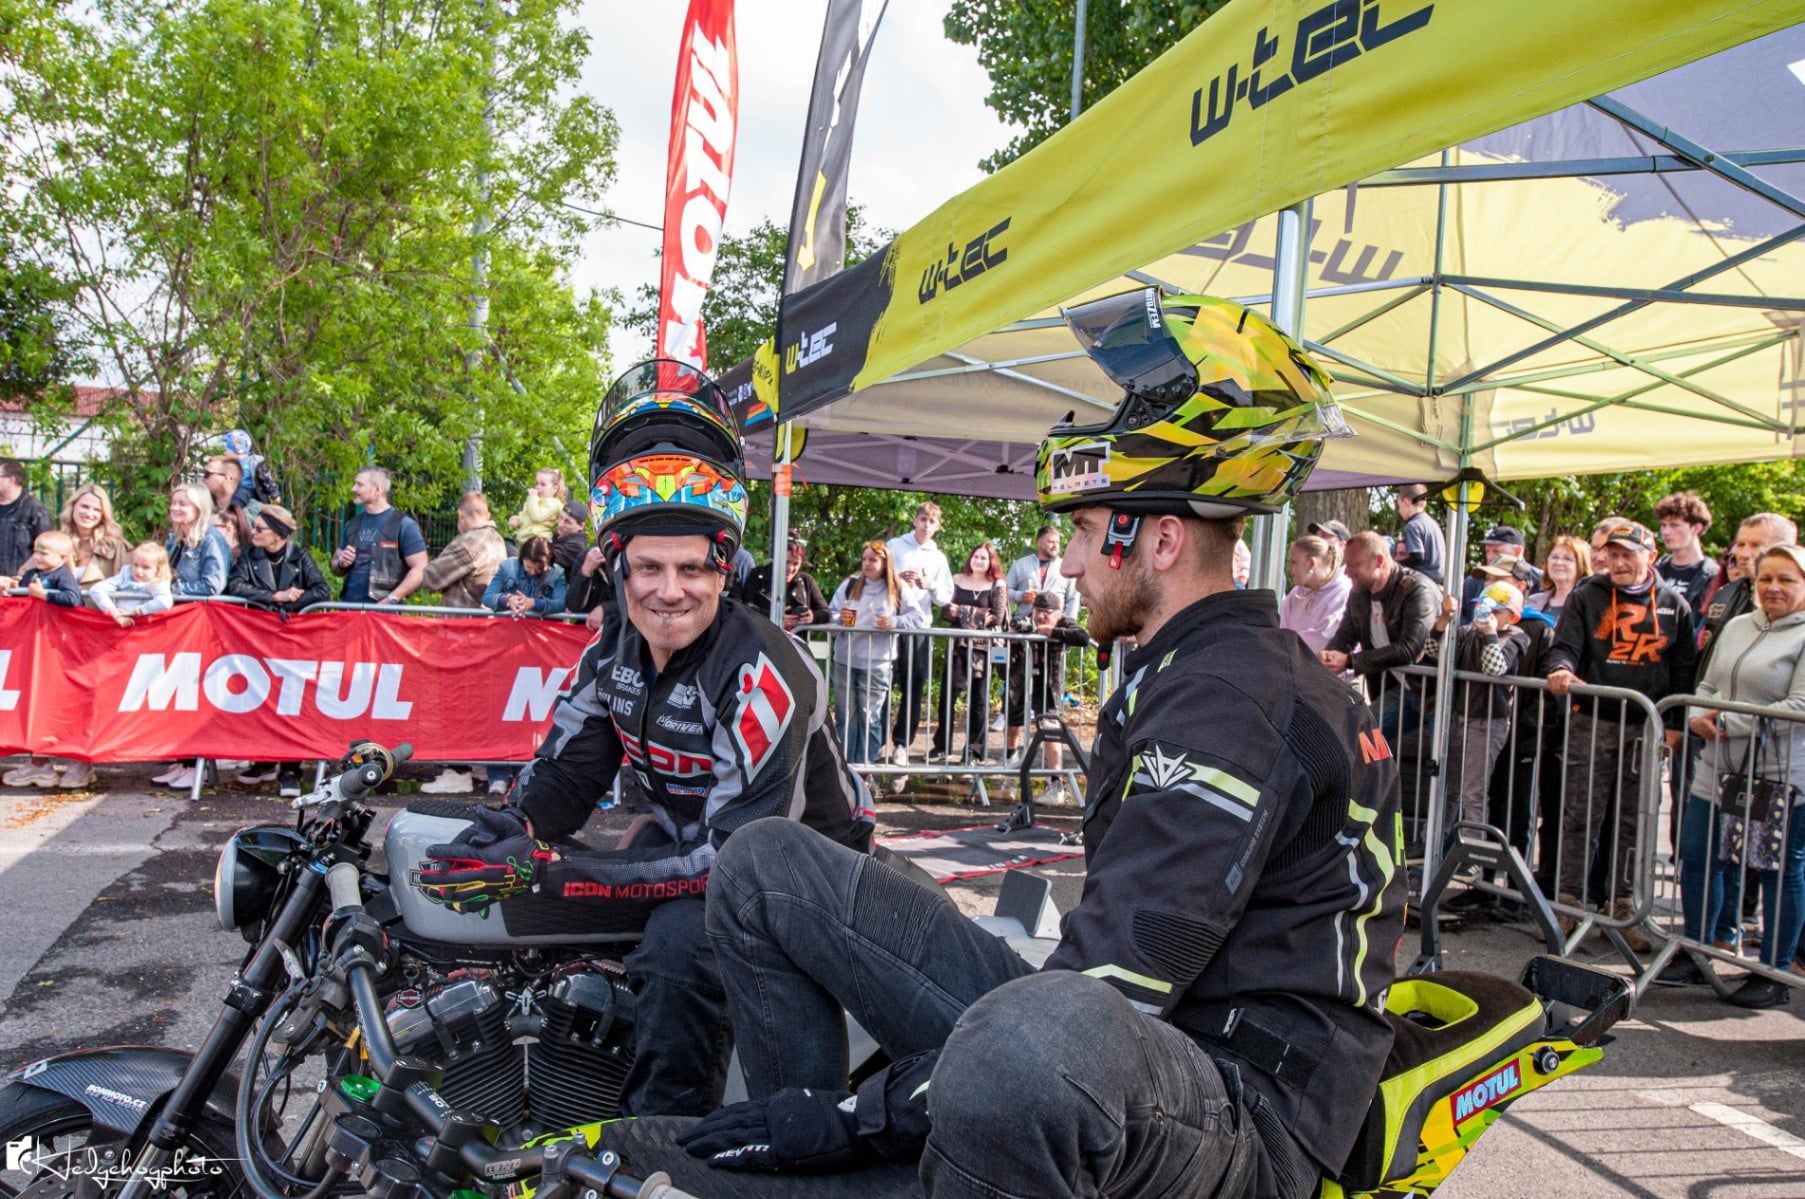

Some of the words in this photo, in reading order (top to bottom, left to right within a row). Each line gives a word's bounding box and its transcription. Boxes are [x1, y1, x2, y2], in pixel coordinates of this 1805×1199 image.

[1053, 446, 1107, 480] MT
[118, 652, 413, 720] MOTUL
[611, 664, 645, 688] EBC
[564, 882, 611, 898] ICON
[1455, 1065, 1519, 1121] MOTUL
